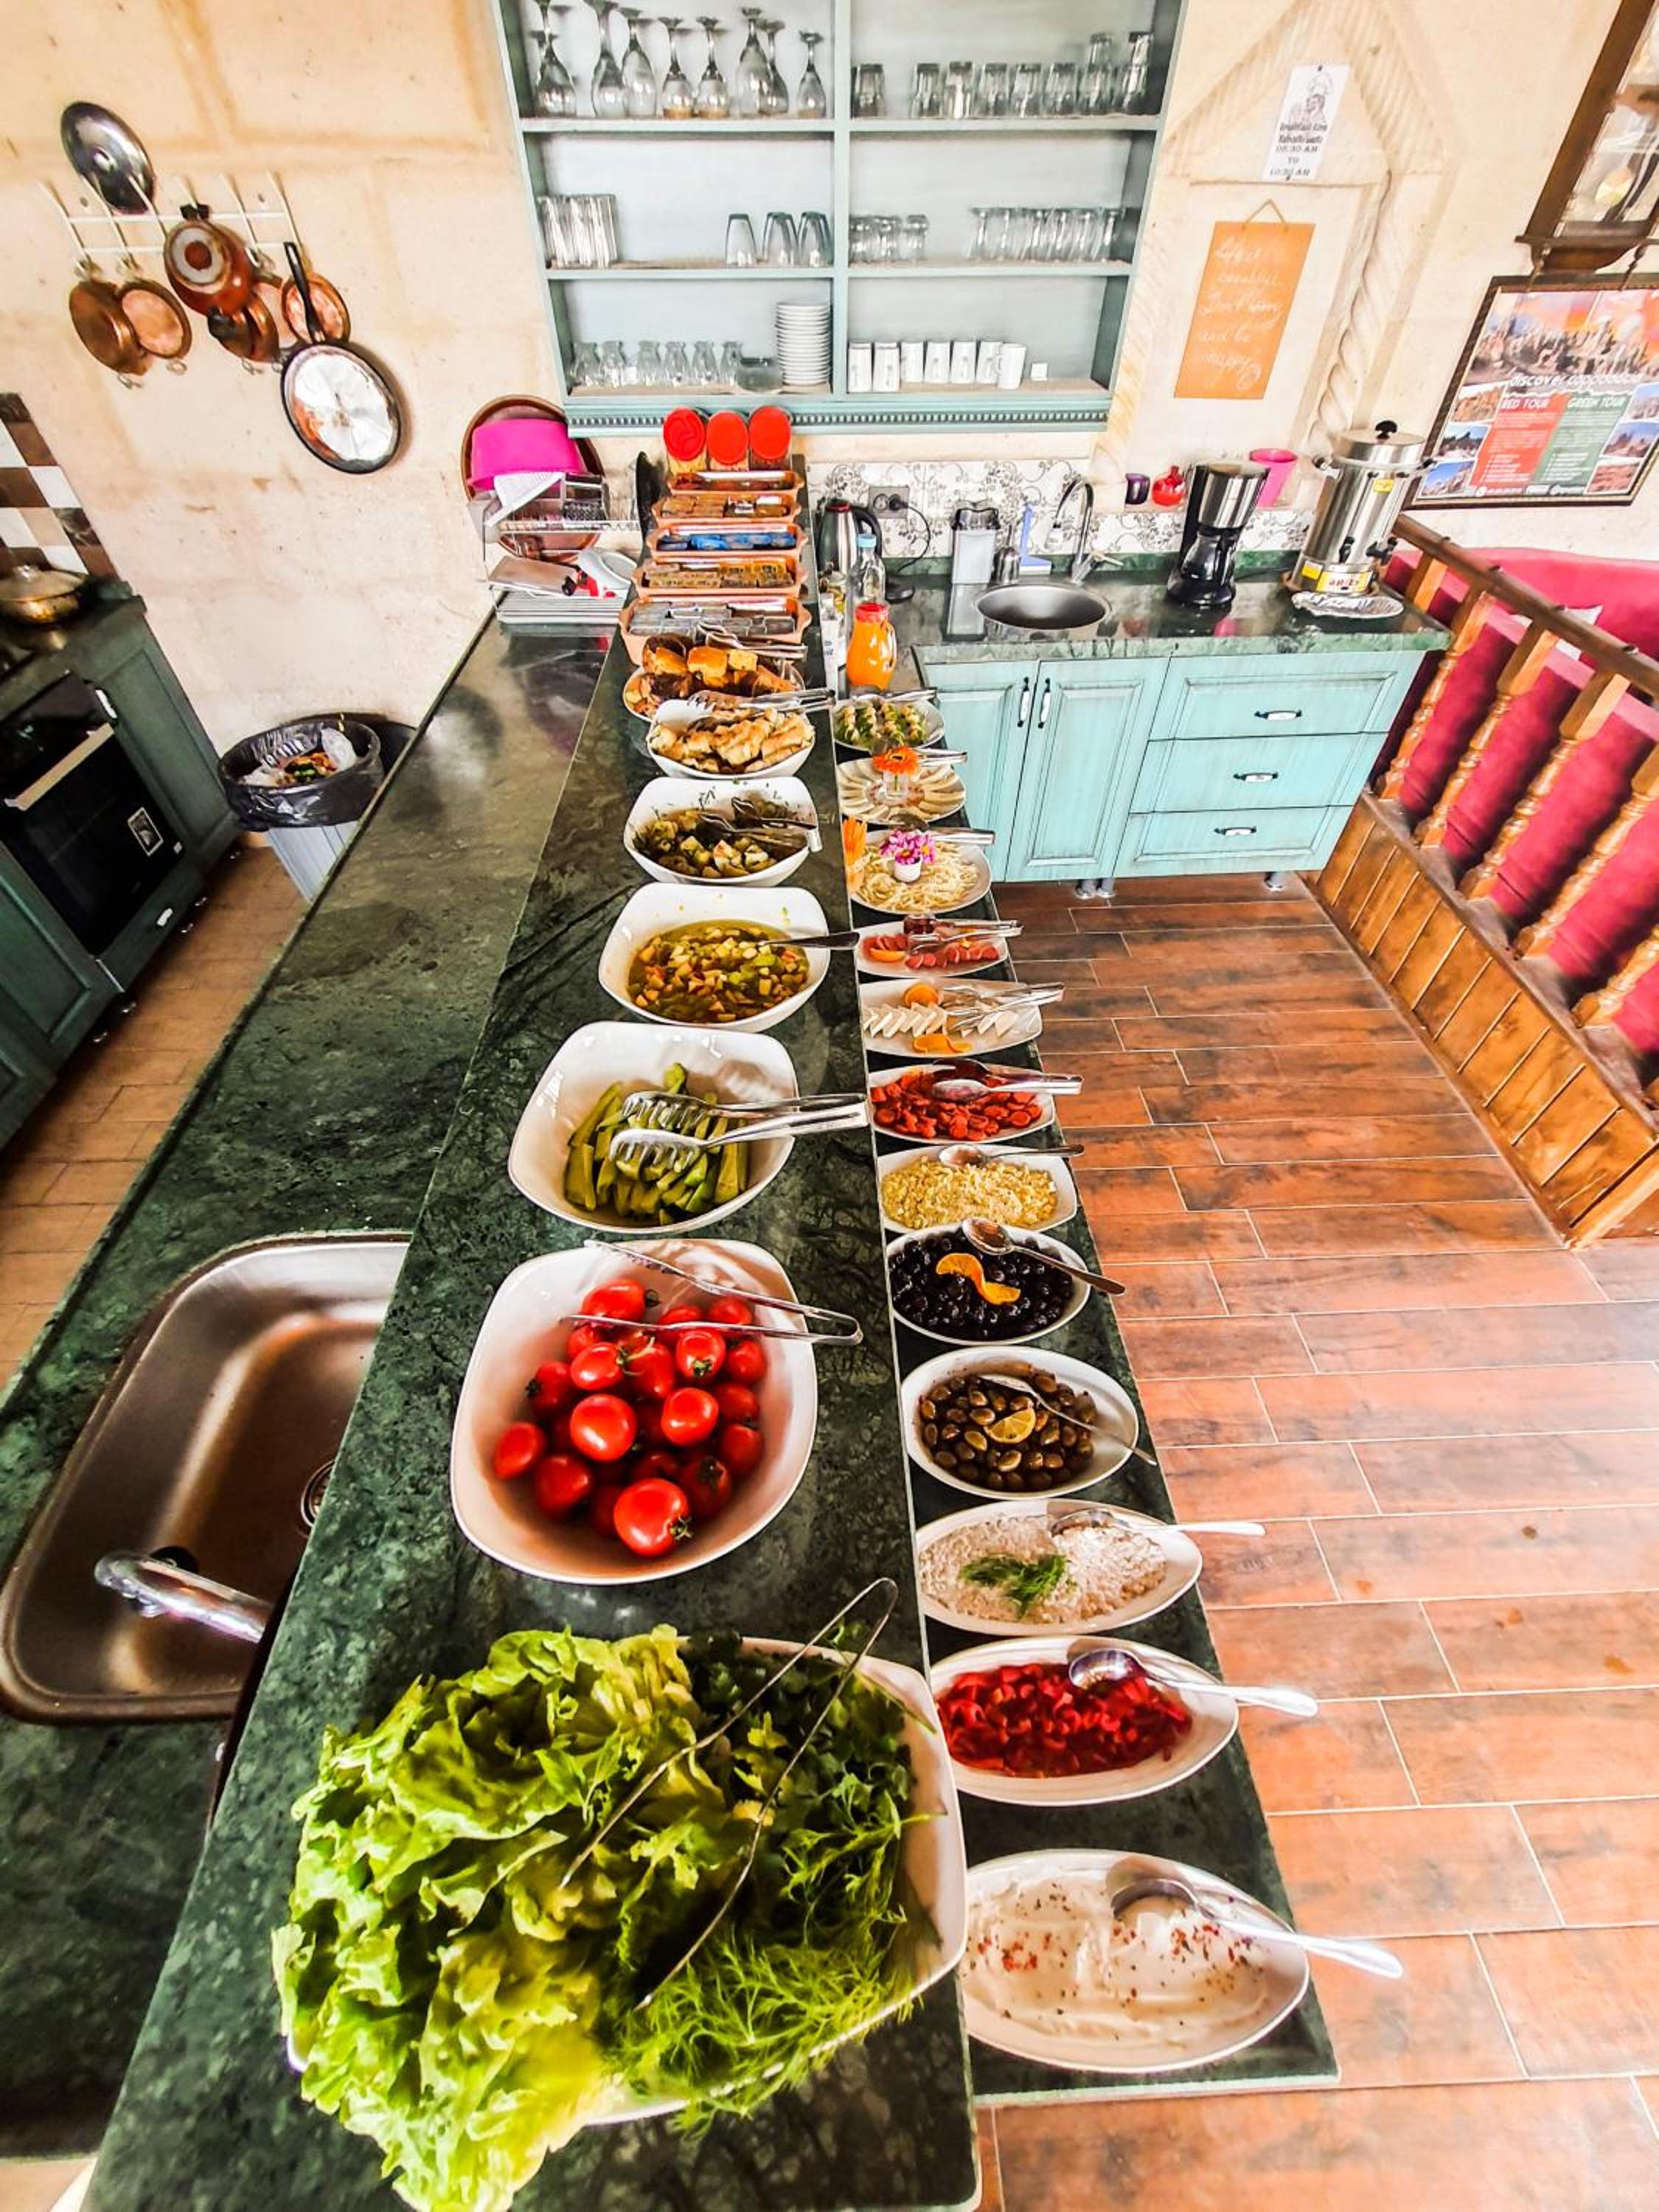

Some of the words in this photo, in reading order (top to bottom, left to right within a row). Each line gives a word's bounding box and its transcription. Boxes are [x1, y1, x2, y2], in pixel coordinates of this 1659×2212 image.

[1295, 168, 1310, 176] AM
[1501, 398, 1520, 409] RED
[1523, 398, 1551, 409] TOUR
[1568, 397, 1599, 408] GREEN
[1602, 397, 1627, 408] TOUR
